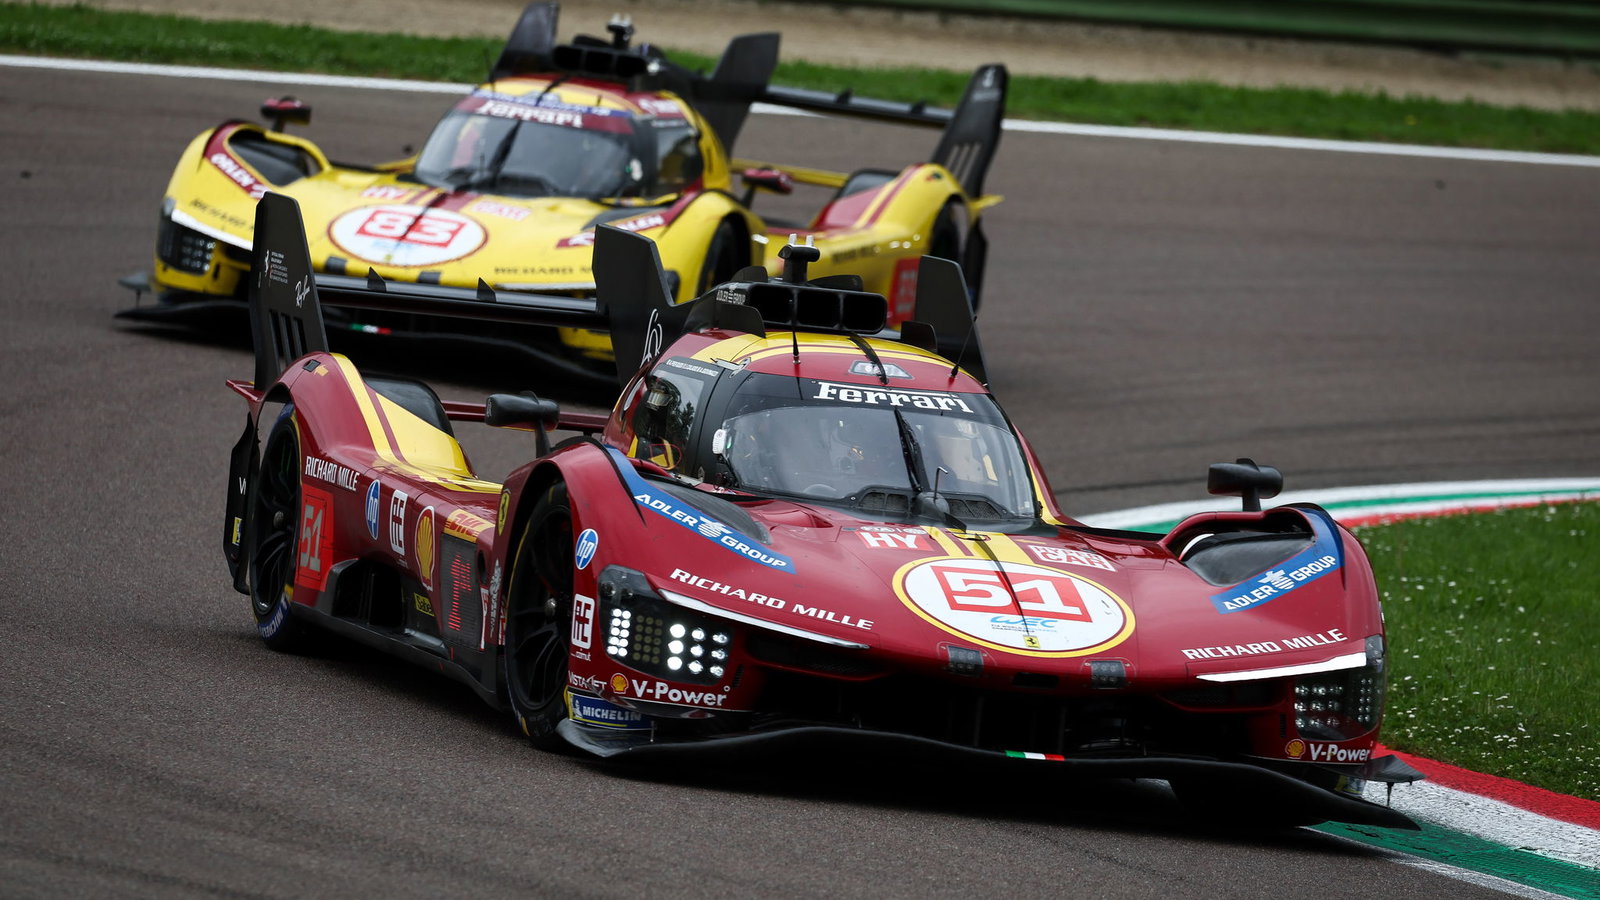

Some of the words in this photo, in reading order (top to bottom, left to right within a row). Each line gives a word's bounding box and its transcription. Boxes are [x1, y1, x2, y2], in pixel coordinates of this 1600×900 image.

[476, 99, 583, 128] Ferrari
[363, 211, 461, 245] 83
[813, 380, 974, 414] Ferrari
[305, 455, 338, 484] RICHARD
[337, 466, 361, 492] MILLE
[299, 503, 323, 572] 51
[634, 493, 697, 528] ADLER
[719, 536, 788, 568] GROUP
[860, 532, 918, 549] HY
[669, 568, 787, 609] RICHARD
[791, 604, 876, 631] MILLE
[939, 570, 1082, 616] 51
[1223, 585, 1278, 611] ADLER
[1288, 555, 1336, 583] GROUP
[1181, 641, 1282, 661] RICHARD
[1281, 628, 1348, 650] MILLE
[631, 679, 727, 707] V-Power
[582, 705, 642, 721] MICHELIN
[1309, 743, 1370, 762] V-Power
